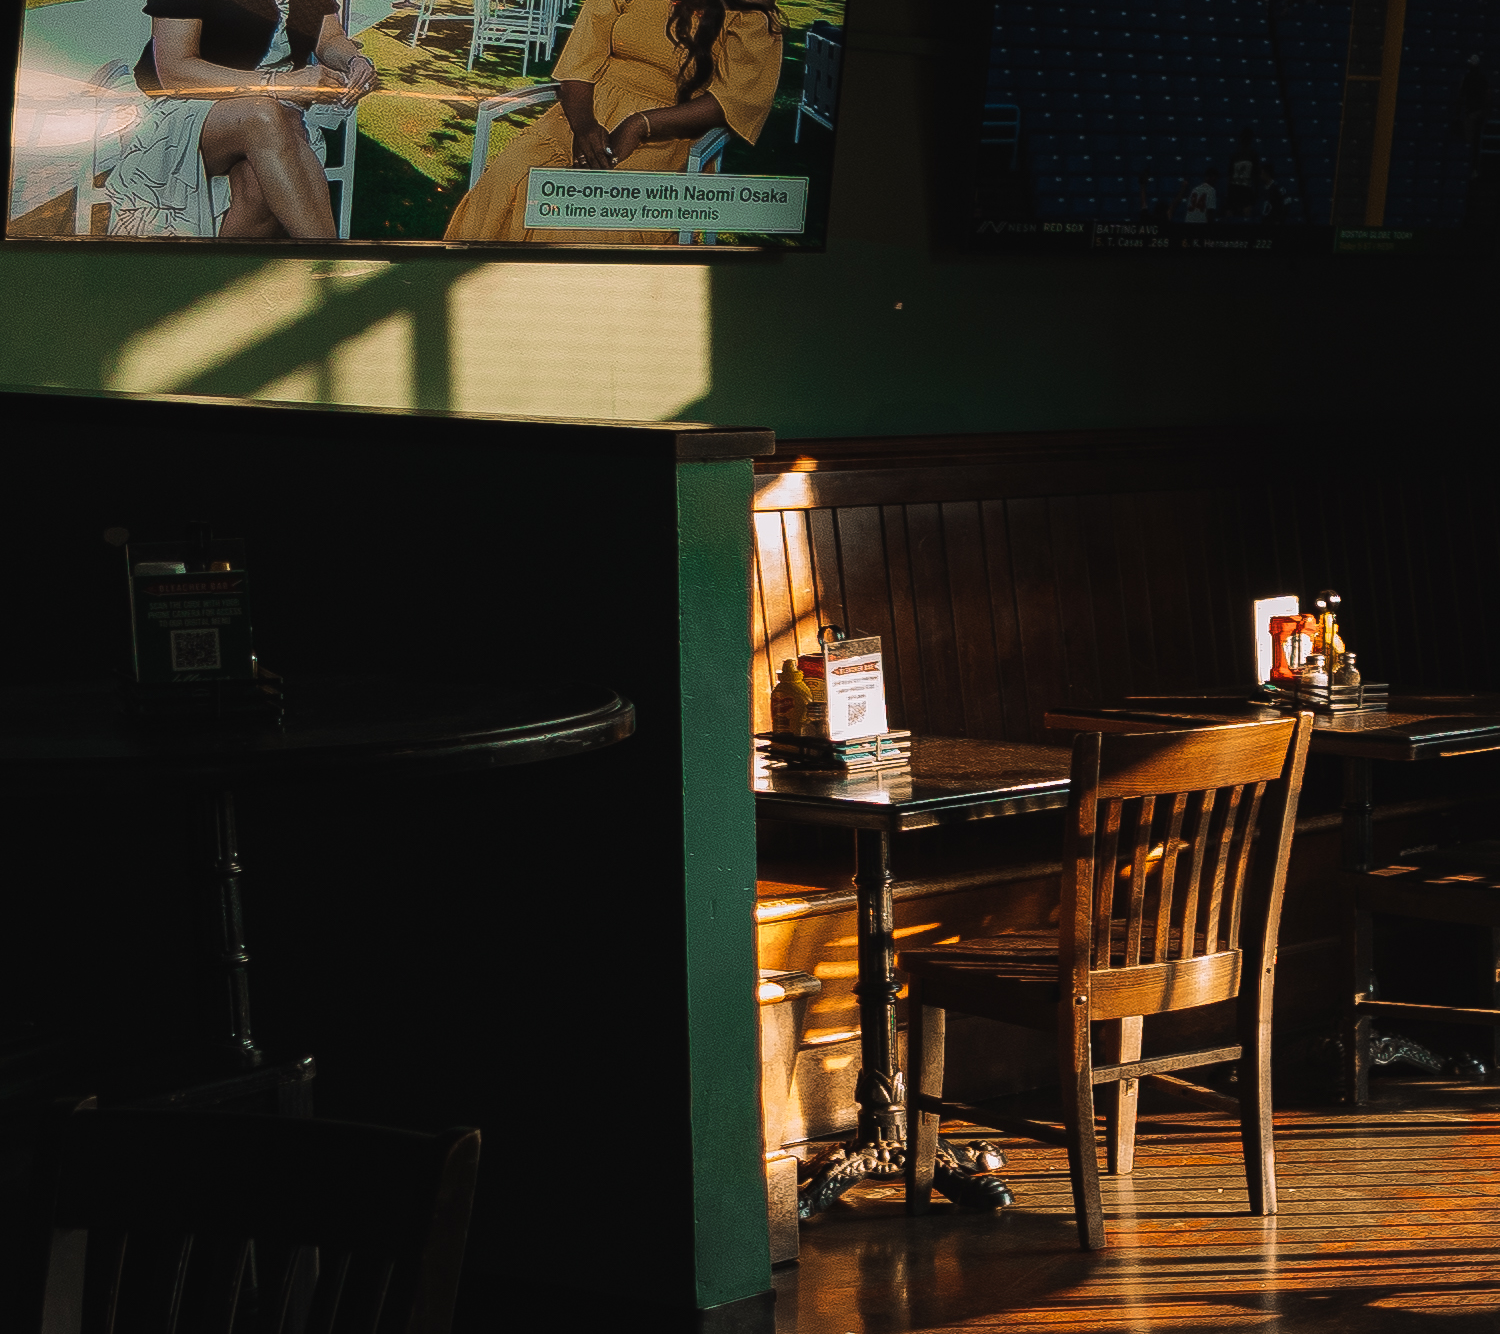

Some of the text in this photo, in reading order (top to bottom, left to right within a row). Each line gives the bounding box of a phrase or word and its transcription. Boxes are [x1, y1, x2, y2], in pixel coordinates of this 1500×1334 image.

[541, 180, 788, 204] One-on-one with Naomi Osaka
[539, 203, 719, 224] On time away from tennis
[1008, 223, 1084, 233] NESN RED SOX
[1096, 224, 1158, 235] BATTING AVG
[1118, 237, 1143, 247] Casas
[159, 583, 206, 592] BLEACHER
